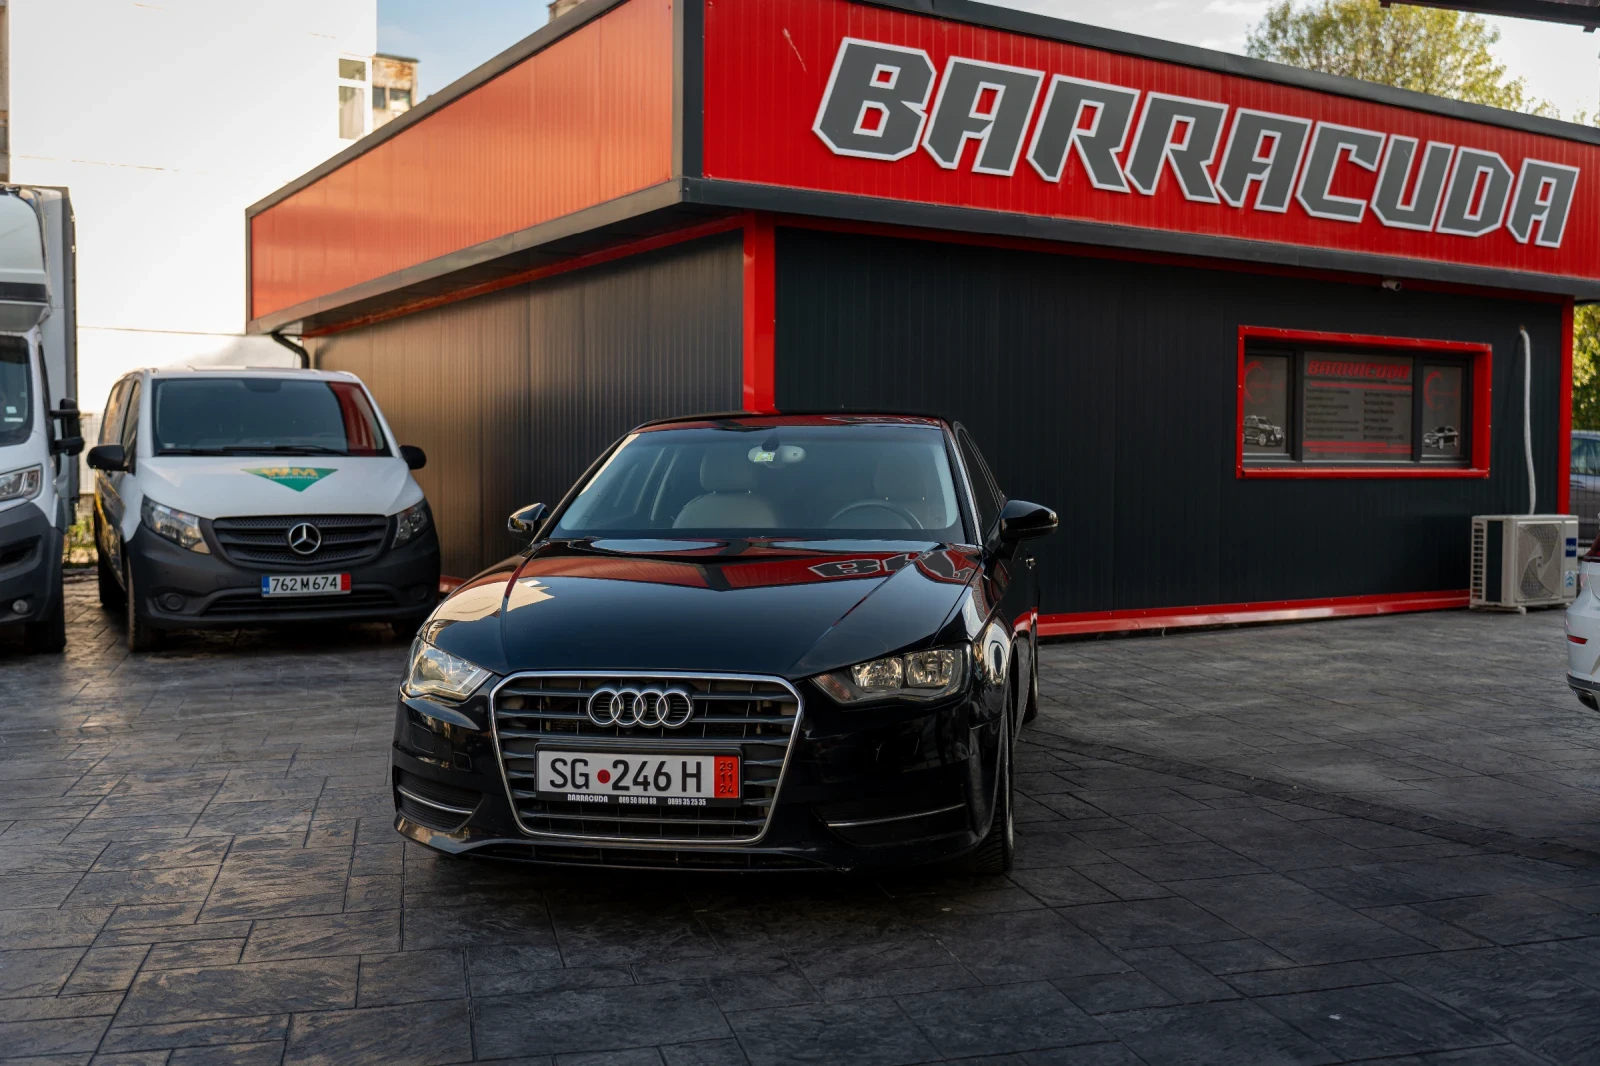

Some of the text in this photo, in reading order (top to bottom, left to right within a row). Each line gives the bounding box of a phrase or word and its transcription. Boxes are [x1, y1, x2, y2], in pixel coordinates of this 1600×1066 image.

[812, 37, 1580, 248] BARRACUDA
[1308, 360, 1409, 379] BARRACUDA
[550, 758, 702, 792] SG 246 H
[719, 772, 733, 783] 11
[719, 783, 733, 793] 24
[567, 793, 608, 803] BARRACUDA
